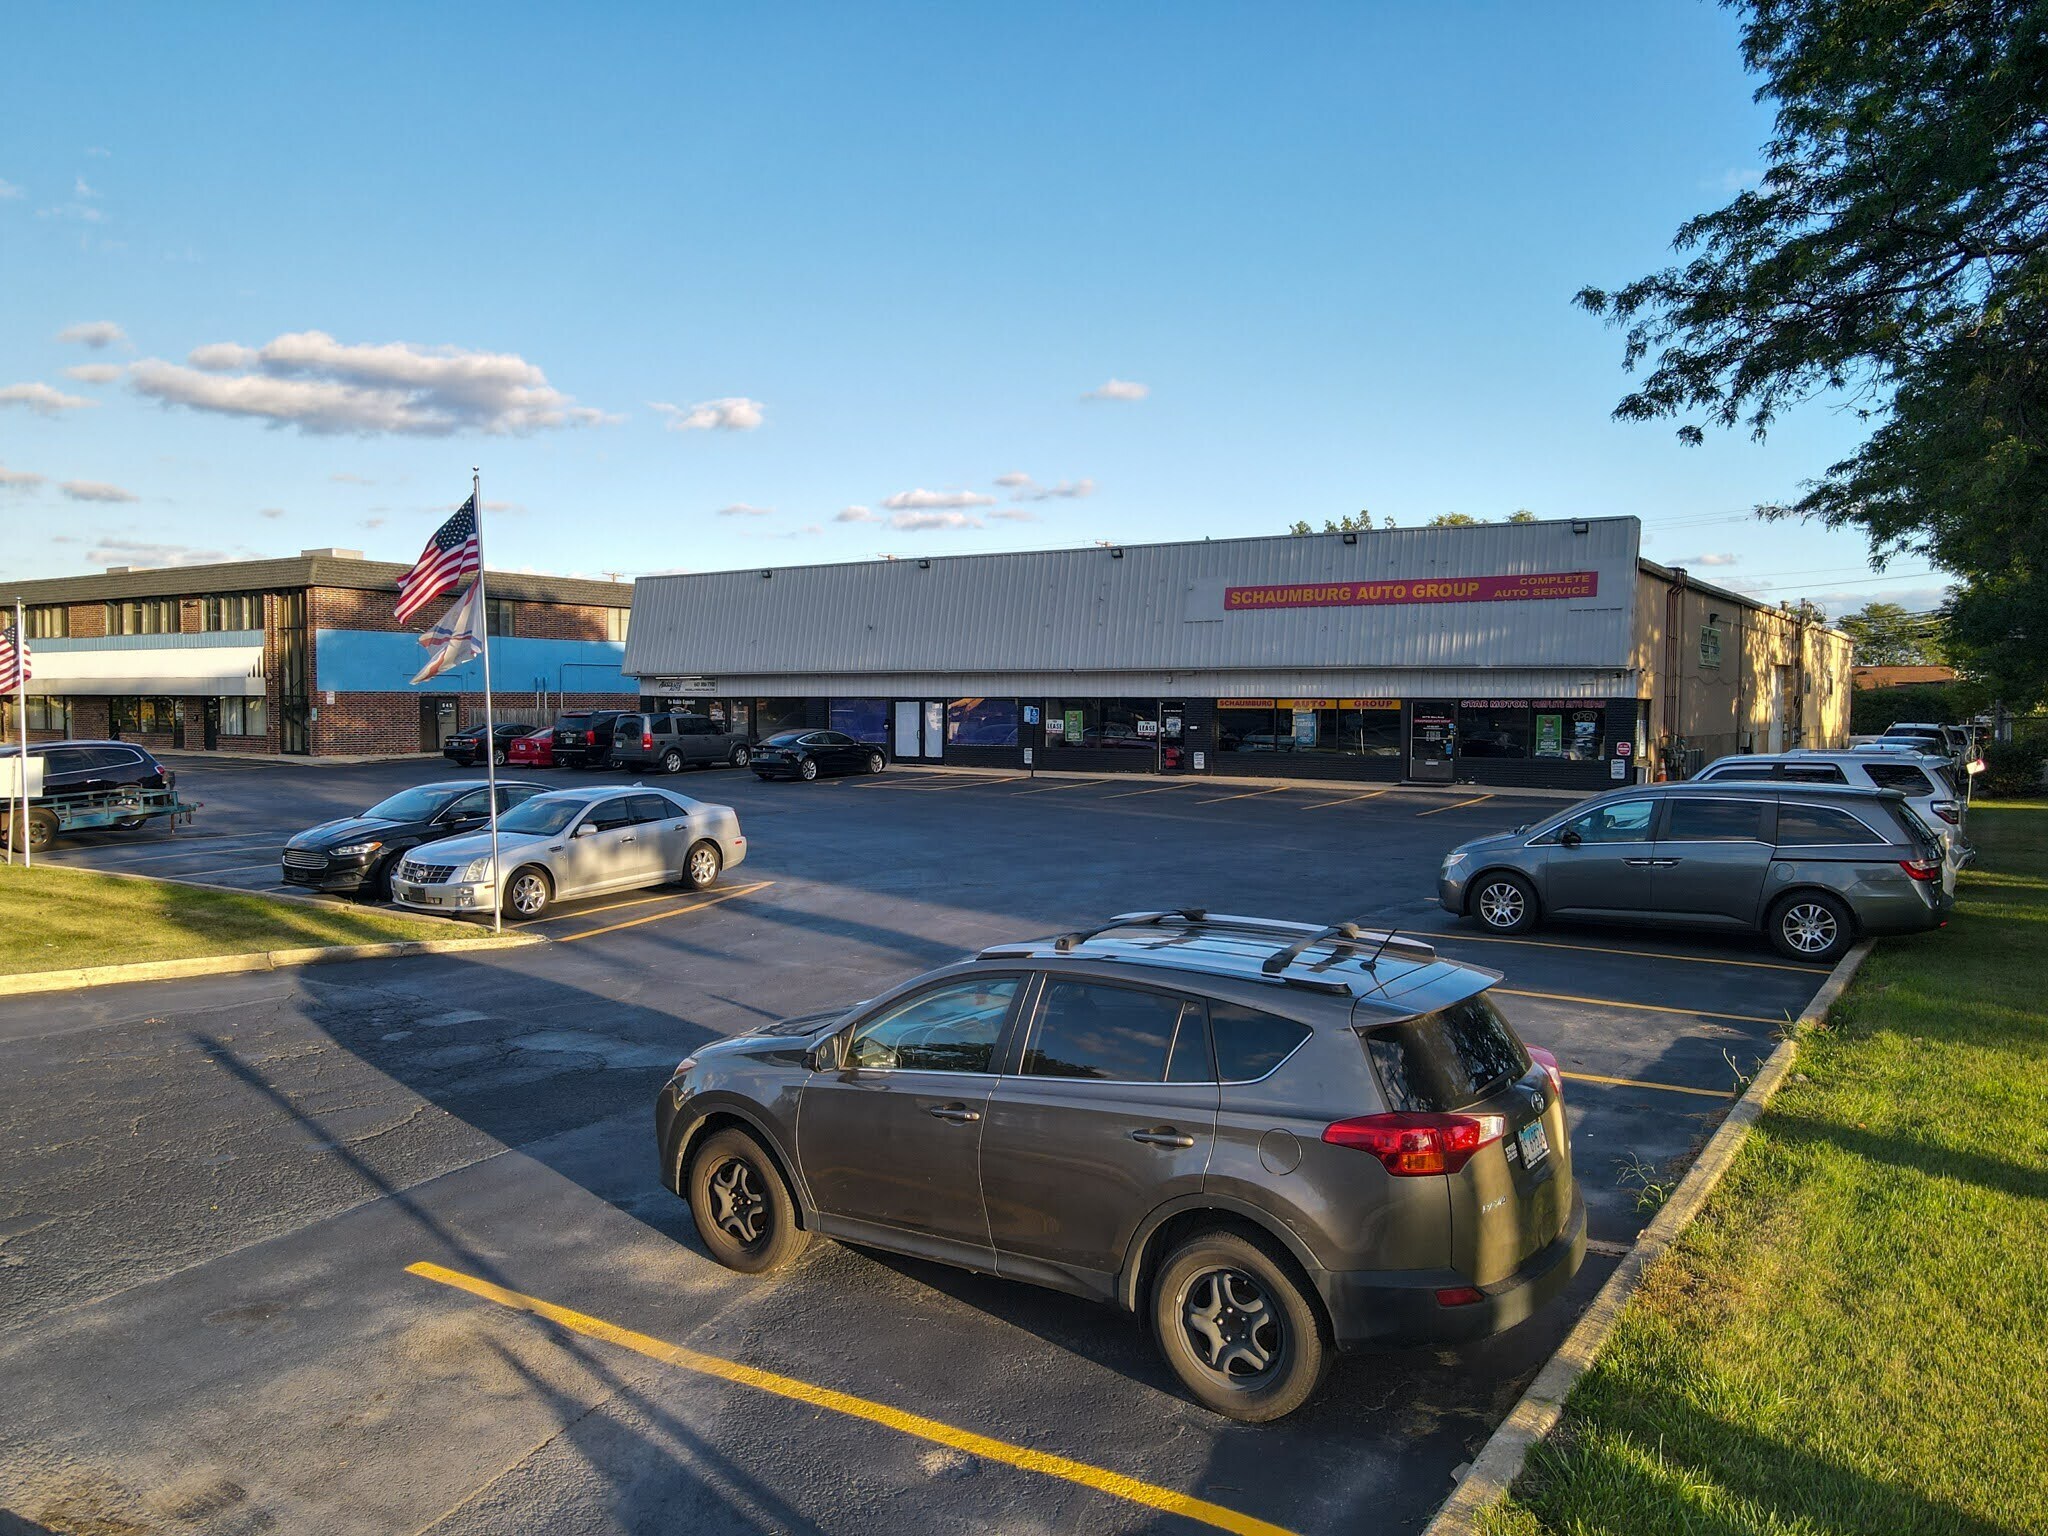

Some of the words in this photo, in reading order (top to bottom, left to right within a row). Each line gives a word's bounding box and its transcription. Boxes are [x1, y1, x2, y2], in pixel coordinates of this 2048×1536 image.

[1519, 575, 1590, 585] COMPLETE
[1231, 587, 1351, 604] SCHAUMBURG
[1356, 584, 1406, 599] AUTO
[1412, 582, 1479, 598] GROUP
[1494, 589, 1529, 598] AUTO
[1533, 586, 1589, 596] SERVICE
[1461, 700, 1488, 708] STAR
[1490, 700, 1528, 708] MOTOR
[1532, 700, 1564, 708] COMPLETE
[1565, 700, 1583, 708] AUTO
[1573, 712, 1597, 721] OPEN
